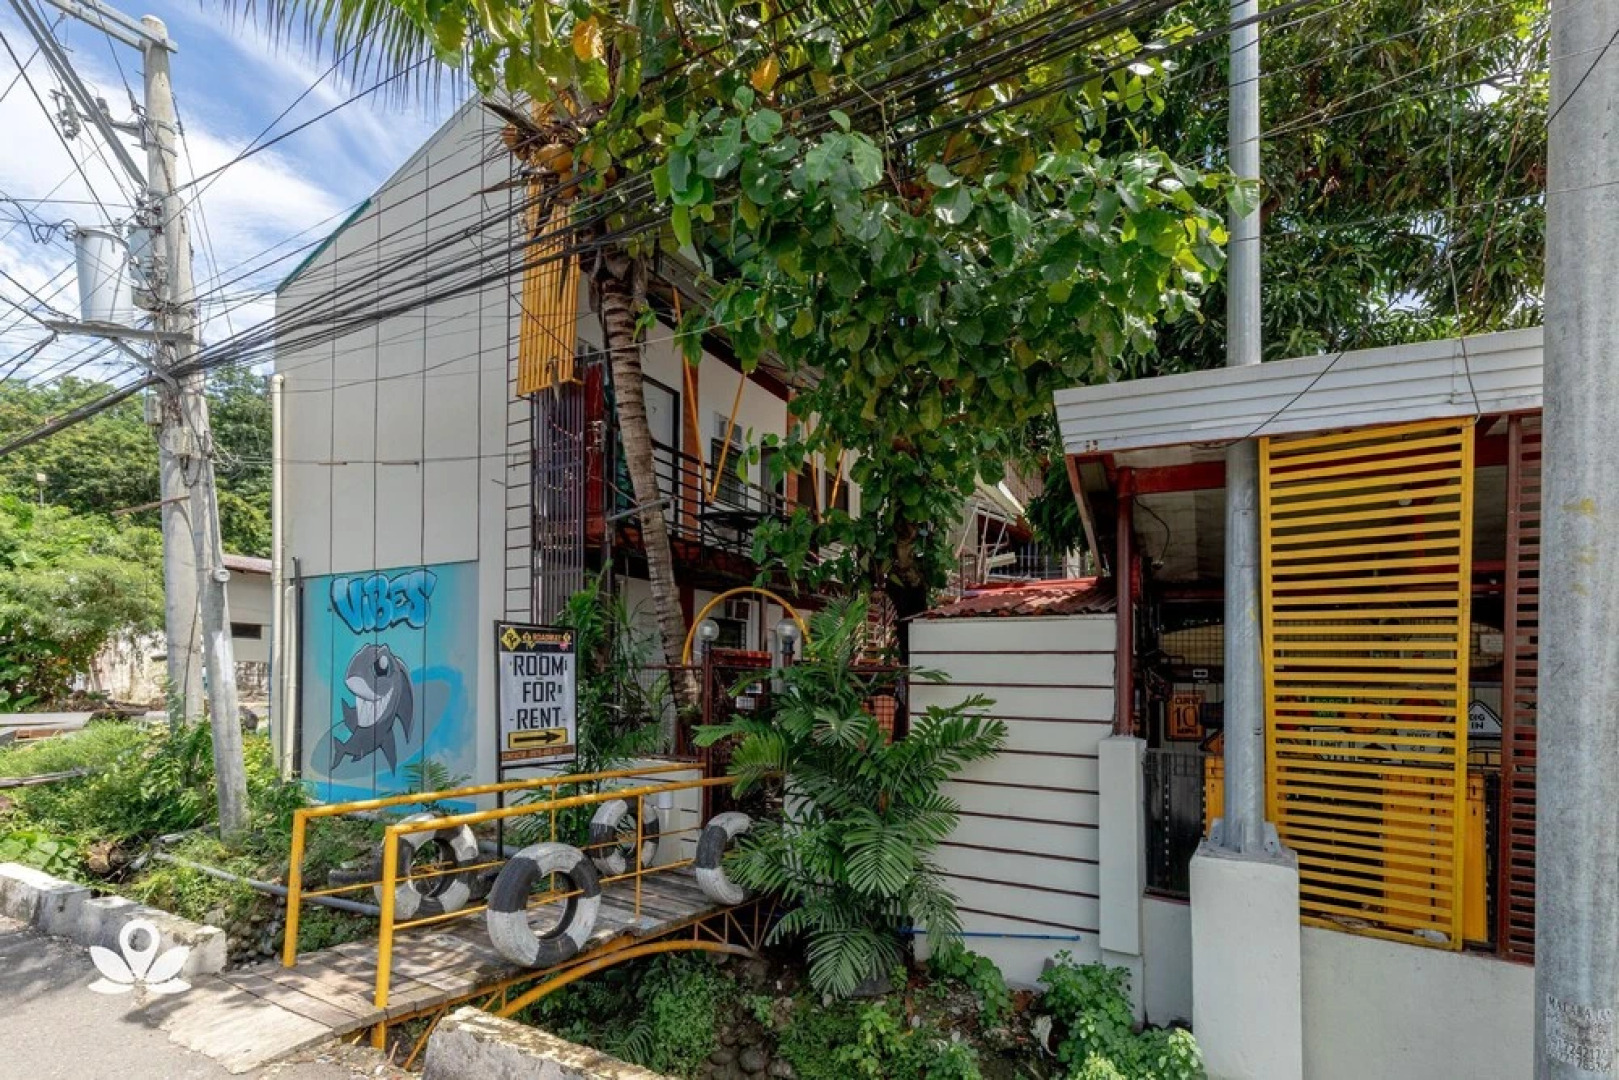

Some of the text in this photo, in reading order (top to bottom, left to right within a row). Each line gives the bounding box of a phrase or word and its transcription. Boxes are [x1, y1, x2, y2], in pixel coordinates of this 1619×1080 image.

[514, 655, 564, 677] ROOM
[522, 681, 556, 703] FOR
[517, 707, 561, 730] RENT
[1471, 722, 1484, 730] IN
